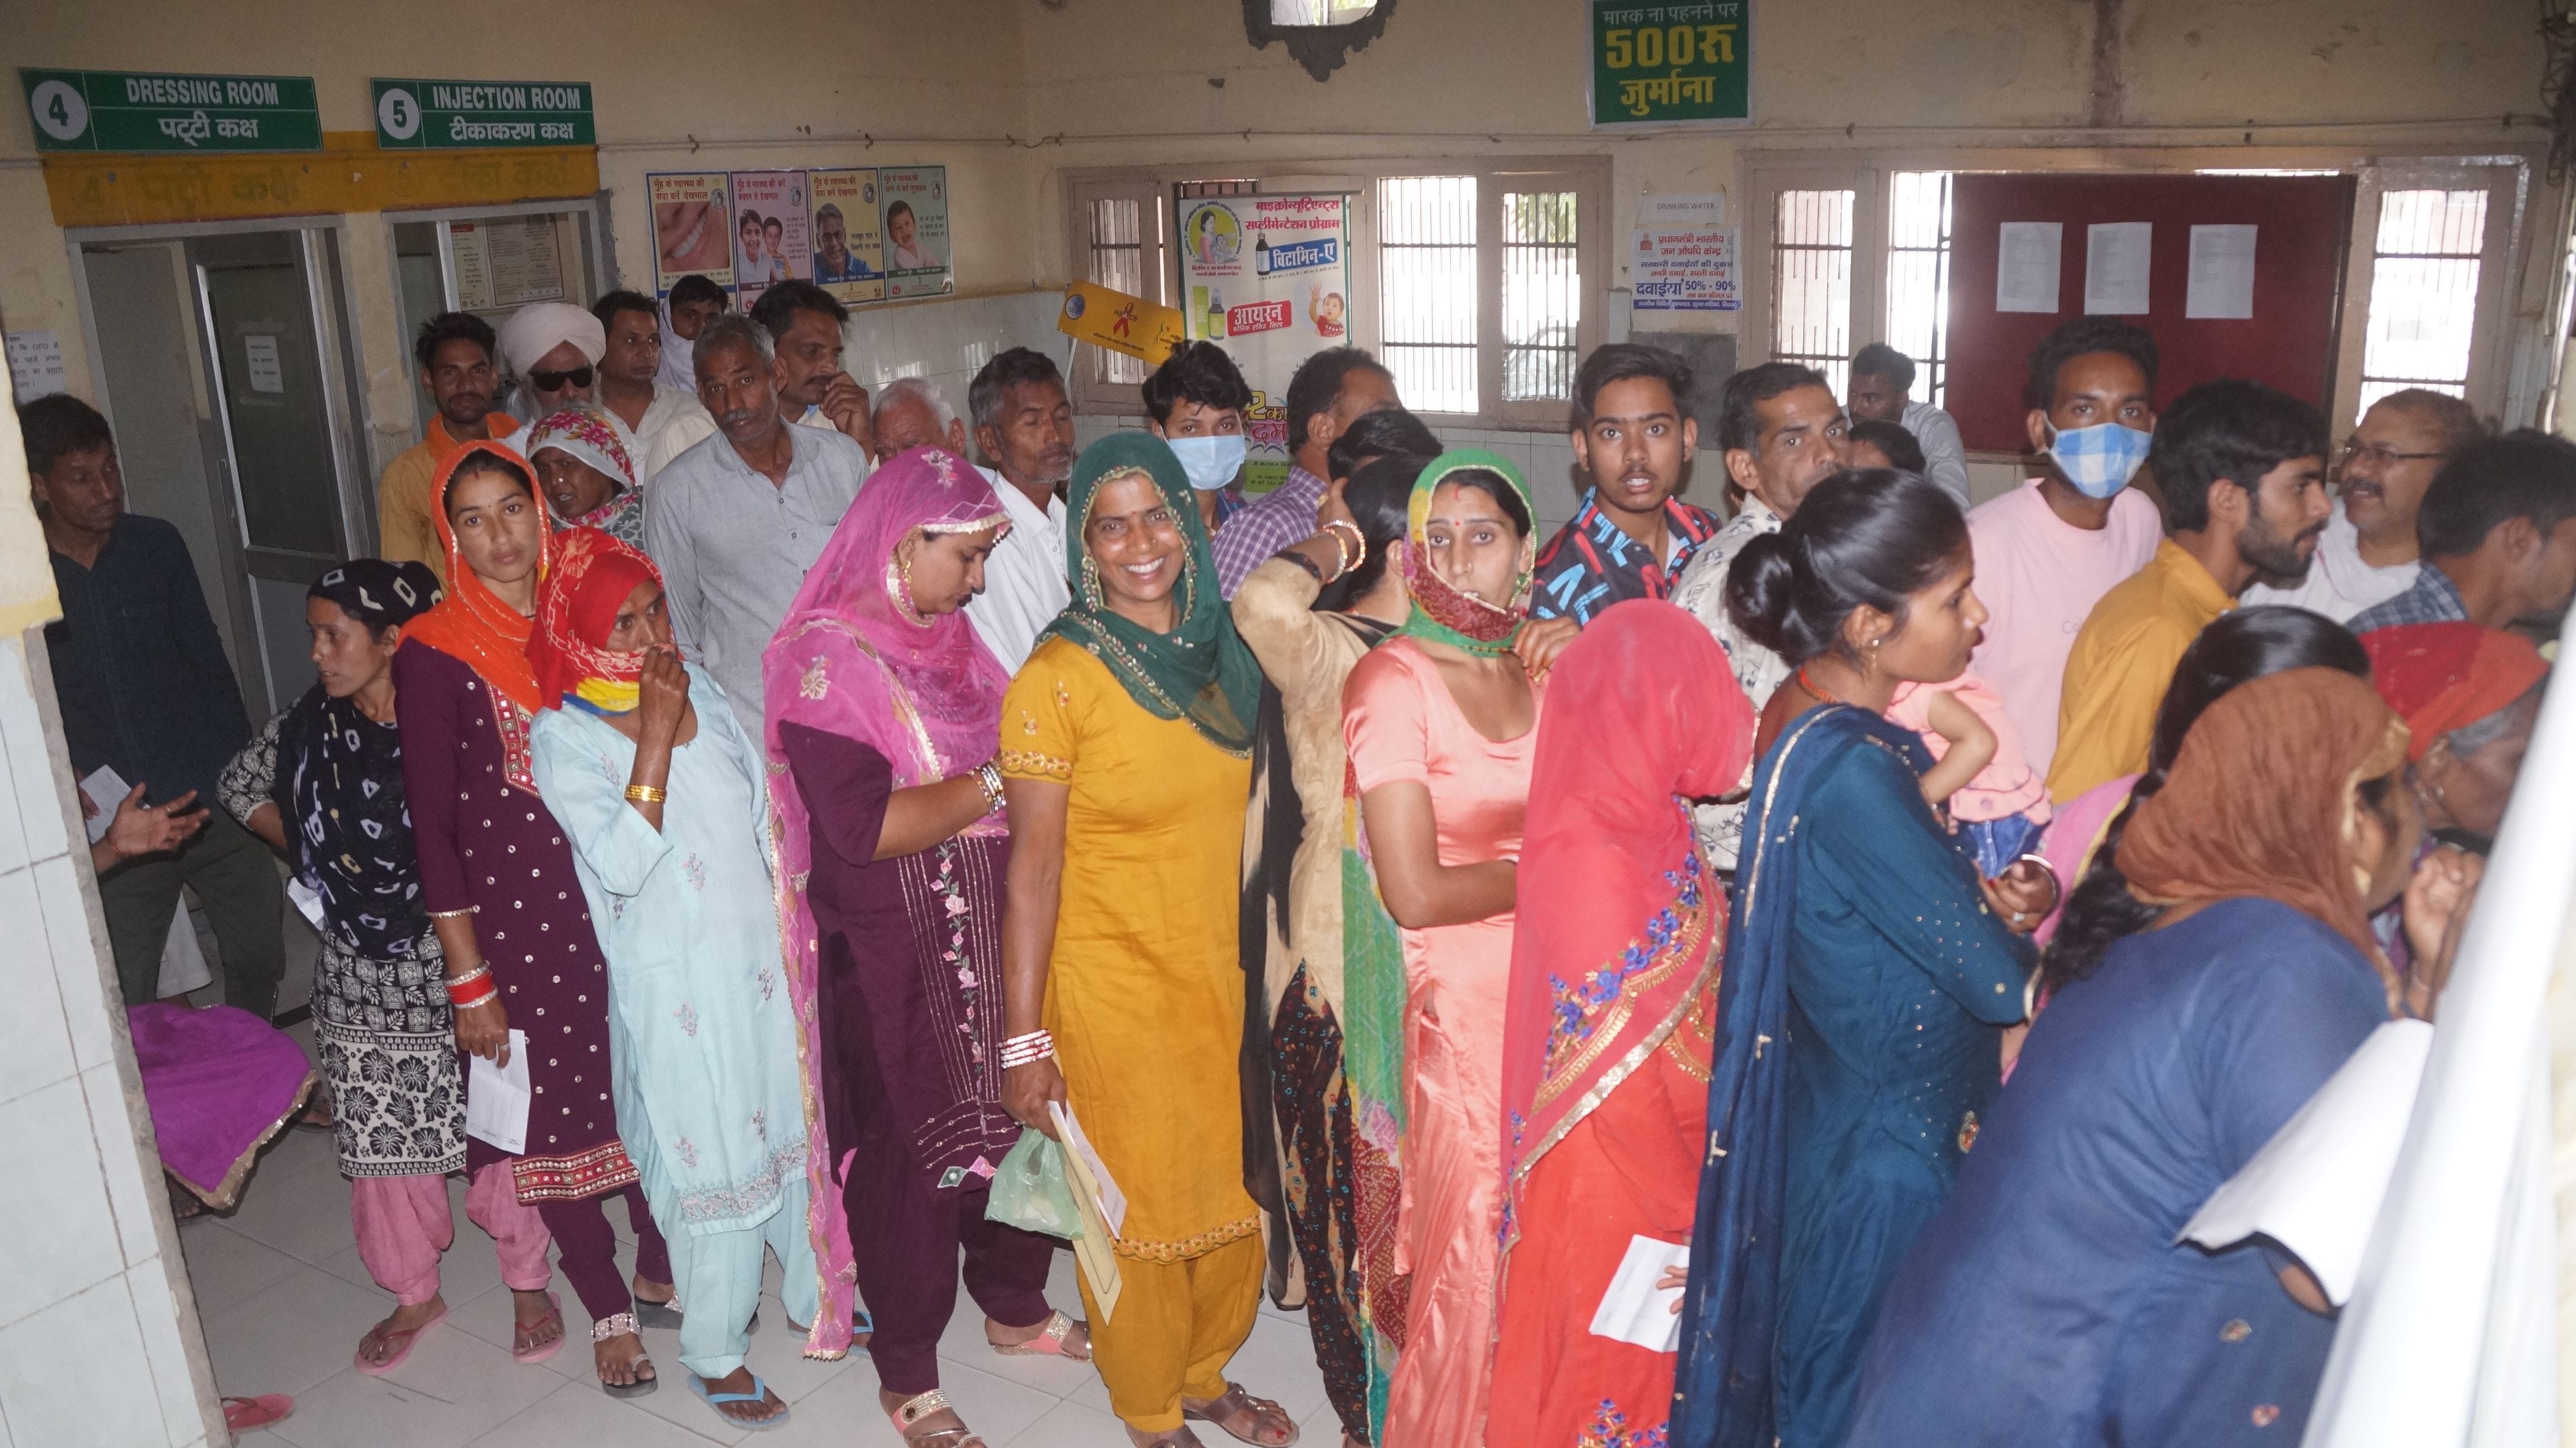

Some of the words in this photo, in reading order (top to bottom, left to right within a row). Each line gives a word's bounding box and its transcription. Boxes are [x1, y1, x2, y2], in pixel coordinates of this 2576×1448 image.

[1603, 9, 1643, 25] मास्क
[1647, 7, 1663, 22] ना
[1667, 1, 1713, 22] पहनने
[1717, 3, 1738, 18] पर
[126, 79, 222, 105] DRESSING
[227, 81, 279, 105] ROOM
[432, 85, 527, 109] INJECTION
[531, 87, 581, 109] ROOM
[1619, 68, 1716, 116] जुर्माना
[49, 94, 69, 126] 4
[393, 99, 408, 128] 5
[216, 120, 259, 138] कक्ष
[449, 116, 536, 140] टीकाकरण
[540, 123, 574, 139] कक्ष
[697, 177, 704, 186] की
[1245, 216, 1307, 230] सप्लीमेन्टेशन
[1309, 216, 1339, 230] प्रोग्राम
[1658, 233, 1693, 244] प्रधानमंत्री
[1696, 233, 1724, 243] भारतीय
[1677, 245, 1701, 256] औषधि
[1703, 245, 1721, 257] केन्द्र
[1685, 281, 1706, 291] 50%
[1715, 280, 1736, 291] 90%
[1235, 304, 1283, 325] आयरन
